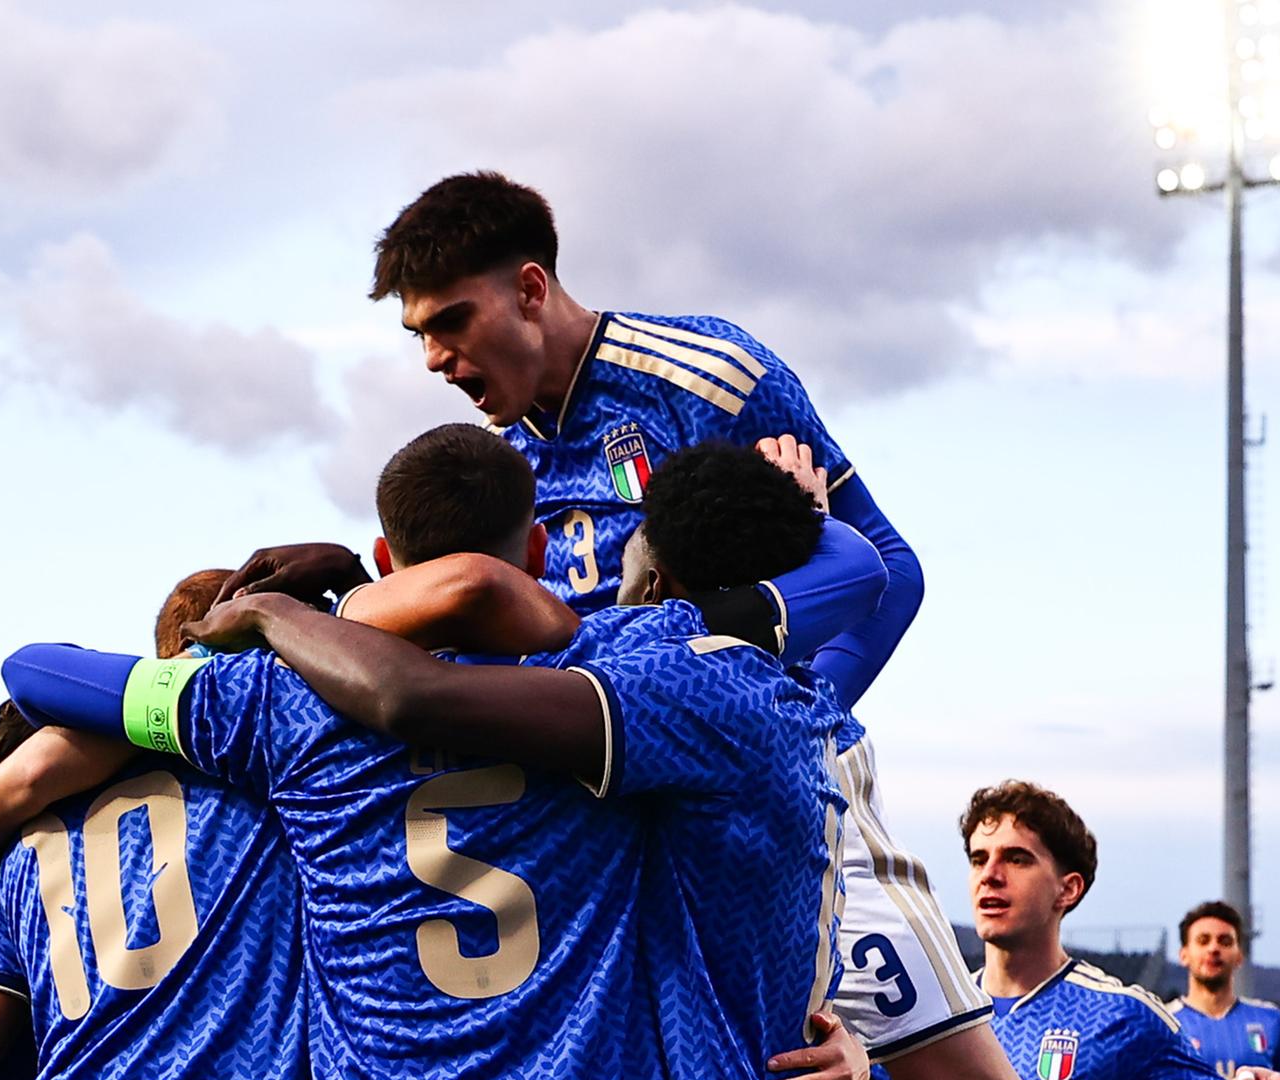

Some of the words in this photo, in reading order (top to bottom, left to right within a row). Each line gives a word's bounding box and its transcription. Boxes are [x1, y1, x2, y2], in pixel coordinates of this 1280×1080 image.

[608, 439, 642, 461] ITALIA
[563, 509, 600, 595] 3
[21, 769, 199, 1021] 10
[405, 763, 540, 999] 5
[851, 932, 918, 1018] 3
[1043, 1040, 1075, 1051] ITALIA
